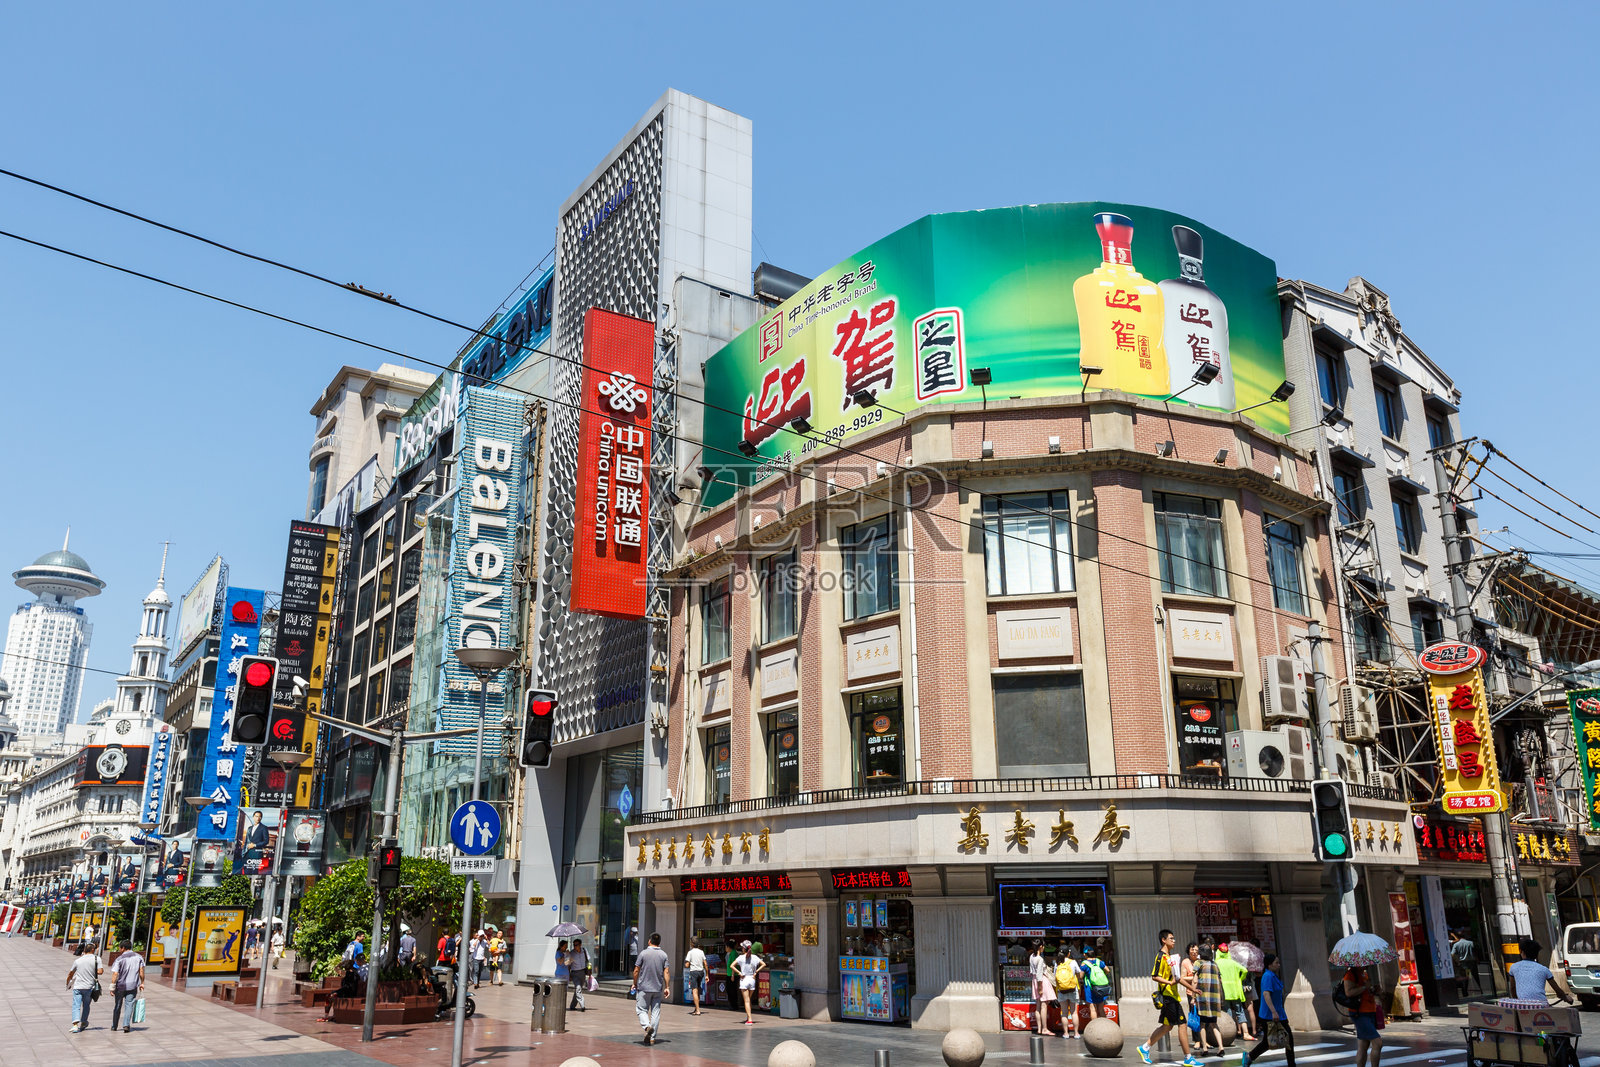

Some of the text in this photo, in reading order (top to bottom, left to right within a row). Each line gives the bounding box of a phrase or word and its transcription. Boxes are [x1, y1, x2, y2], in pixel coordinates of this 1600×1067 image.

[581, 178, 634, 242] SAMSUNG
[788, 260, 876, 323] 中华老字号
[787, 279, 877, 338] China Time-honored Brand
[919, 319, 956, 392] 之星
[801, 409, 882, 454] 400-888-9929
[595, 421, 615, 541] China unicom
[614, 425, 644, 547] 中国联通
[290, 563, 318, 572] RESTAURANT
[291, 556, 314, 565] COFFEE
[321, 590, 330, 606] 6
[284, 612, 312, 627] 陶瓷
[1010, 625, 1060, 641] LAO DA FANG
[313, 664, 322, 680] 4
[1437, 697, 1456, 768] 中华名小吃
[304, 742, 313, 755] 2
[147, 742, 166, 832] 上海市第一医药商
[302, 781, 307, 798] 1
[1450, 796, 1492, 808] 汤包馆
[957, 804, 1131, 849] 真老大房
[453, 860, 493, 870] 特种车辆除外
[700, 875, 771, 892] 上海真老大房食品公司
[1018, 902, 1086, 915] 上海老酸奶
